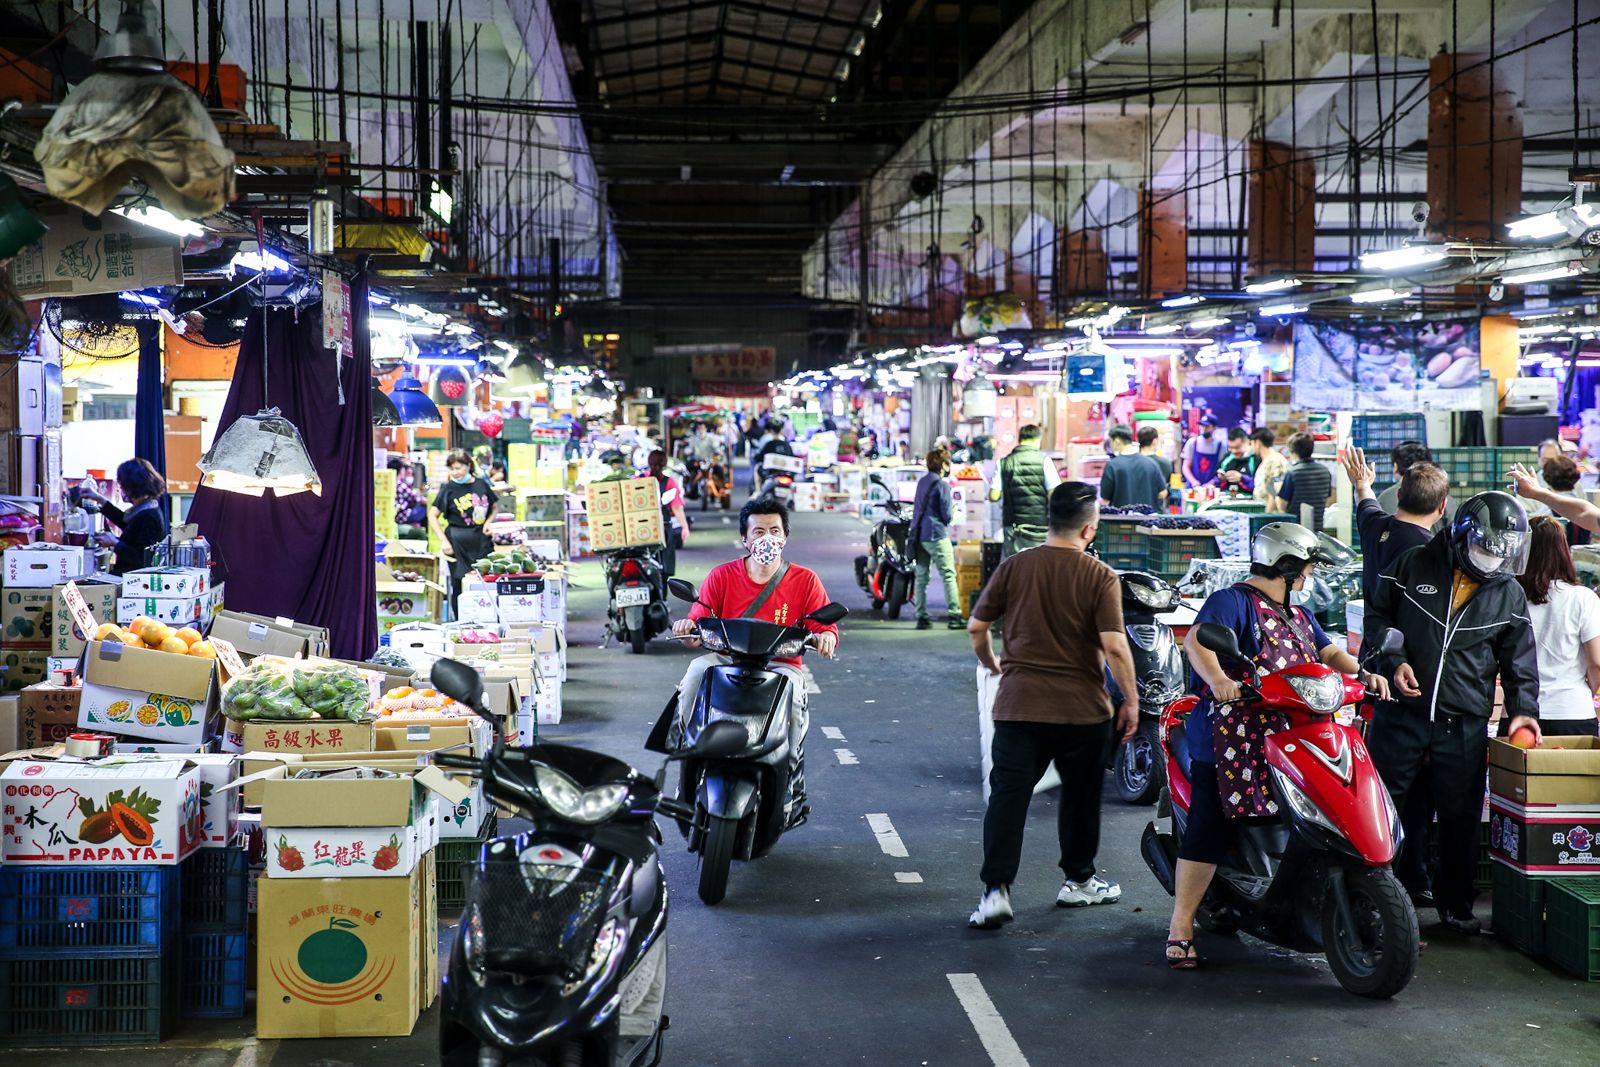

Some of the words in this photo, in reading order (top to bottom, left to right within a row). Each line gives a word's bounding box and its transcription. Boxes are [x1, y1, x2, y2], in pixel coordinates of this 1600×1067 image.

[58, 595, 70, 651] 分級包裝
[263, 727, 344, 749] 高級水果
[22, 805, 79, 846] 木瓜
[68, 847, 157, 861] PAPAYA
